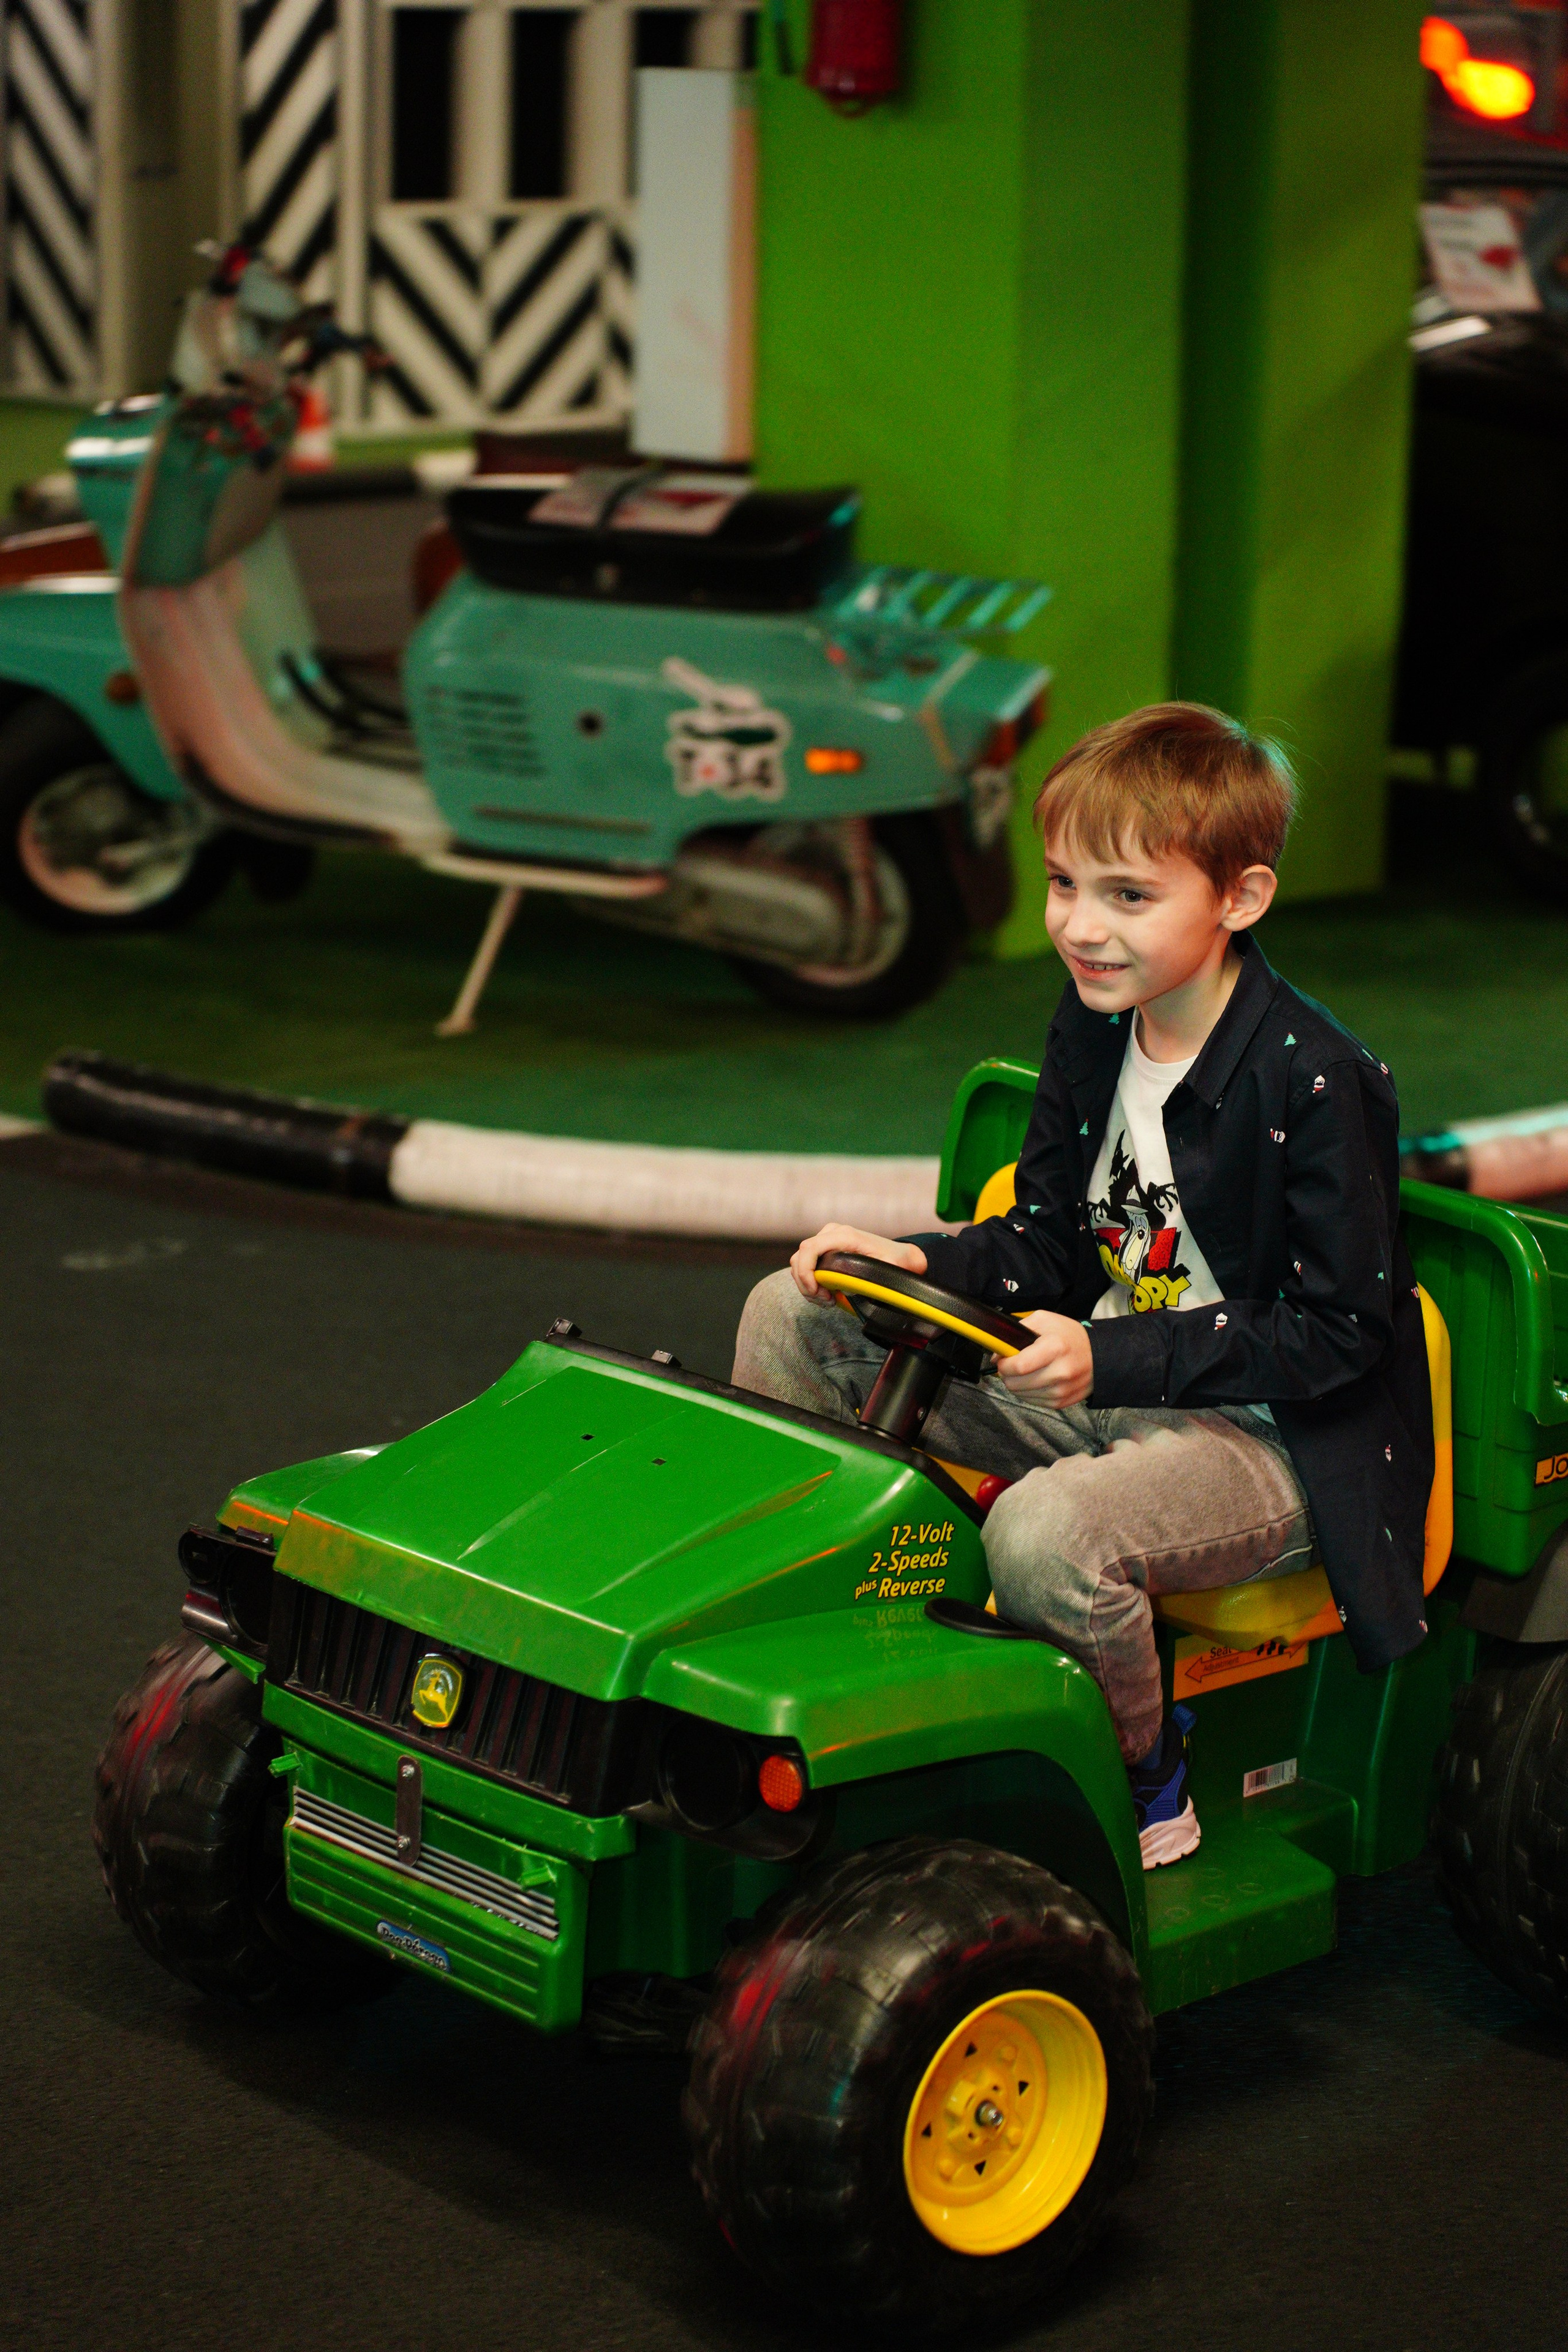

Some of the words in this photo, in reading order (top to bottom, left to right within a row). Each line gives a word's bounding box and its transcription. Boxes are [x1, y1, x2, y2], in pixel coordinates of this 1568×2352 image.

[890, 1521, 954, 1547] 12-Volt
[868, 1546, 949, 1577] 2-Speeds
[854, 1579, 877, 1600] plus
[878, 1578, 946, 1598] Reverse
